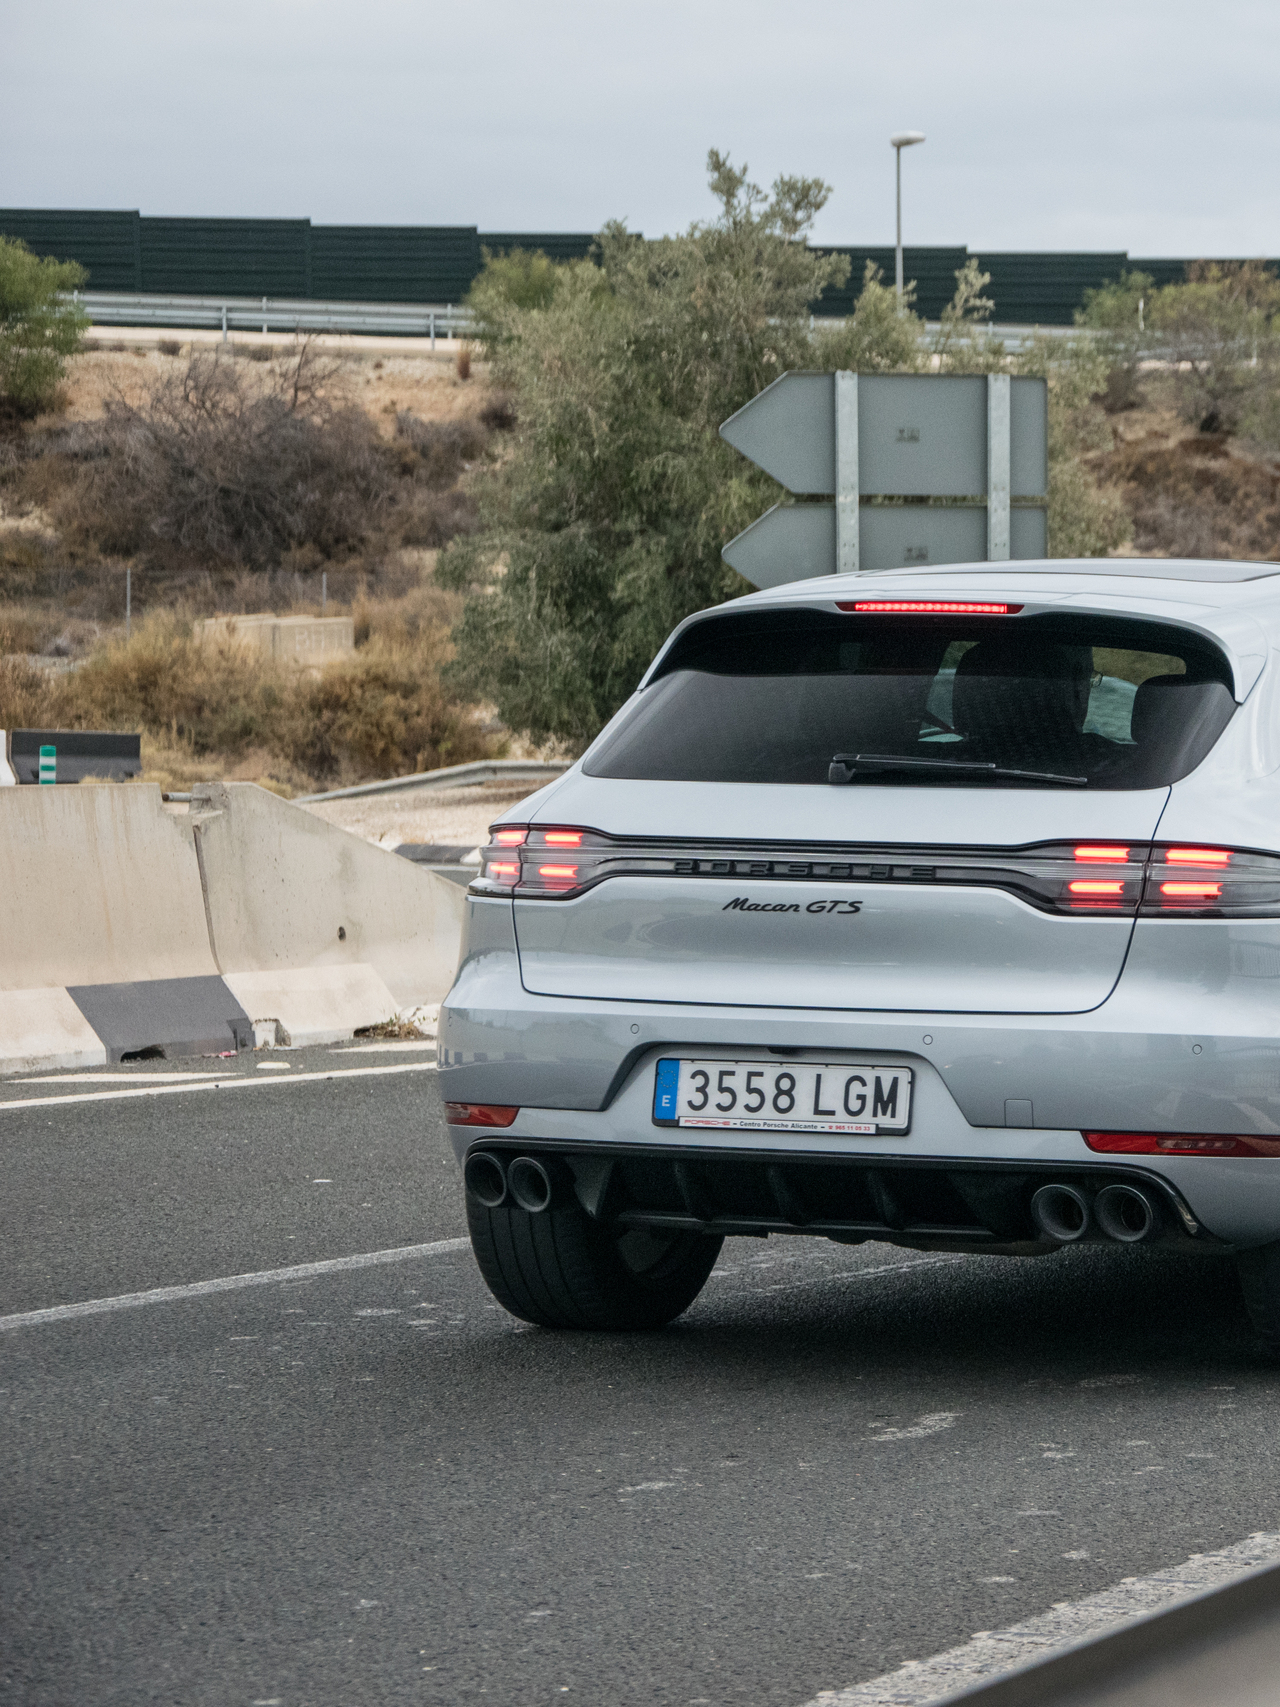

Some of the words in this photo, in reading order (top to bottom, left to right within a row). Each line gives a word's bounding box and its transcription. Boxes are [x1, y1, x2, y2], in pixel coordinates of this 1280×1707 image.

[674, 859, 935, 878] PORSCHE
[722, 897, 799, 913] Macan
[806, 900, 863, 914] GTS
[661, 1095, 671, 1107] E
[687, 1070, 796, 1114] 3558
[813, 1073, 899, 1119] LGM
